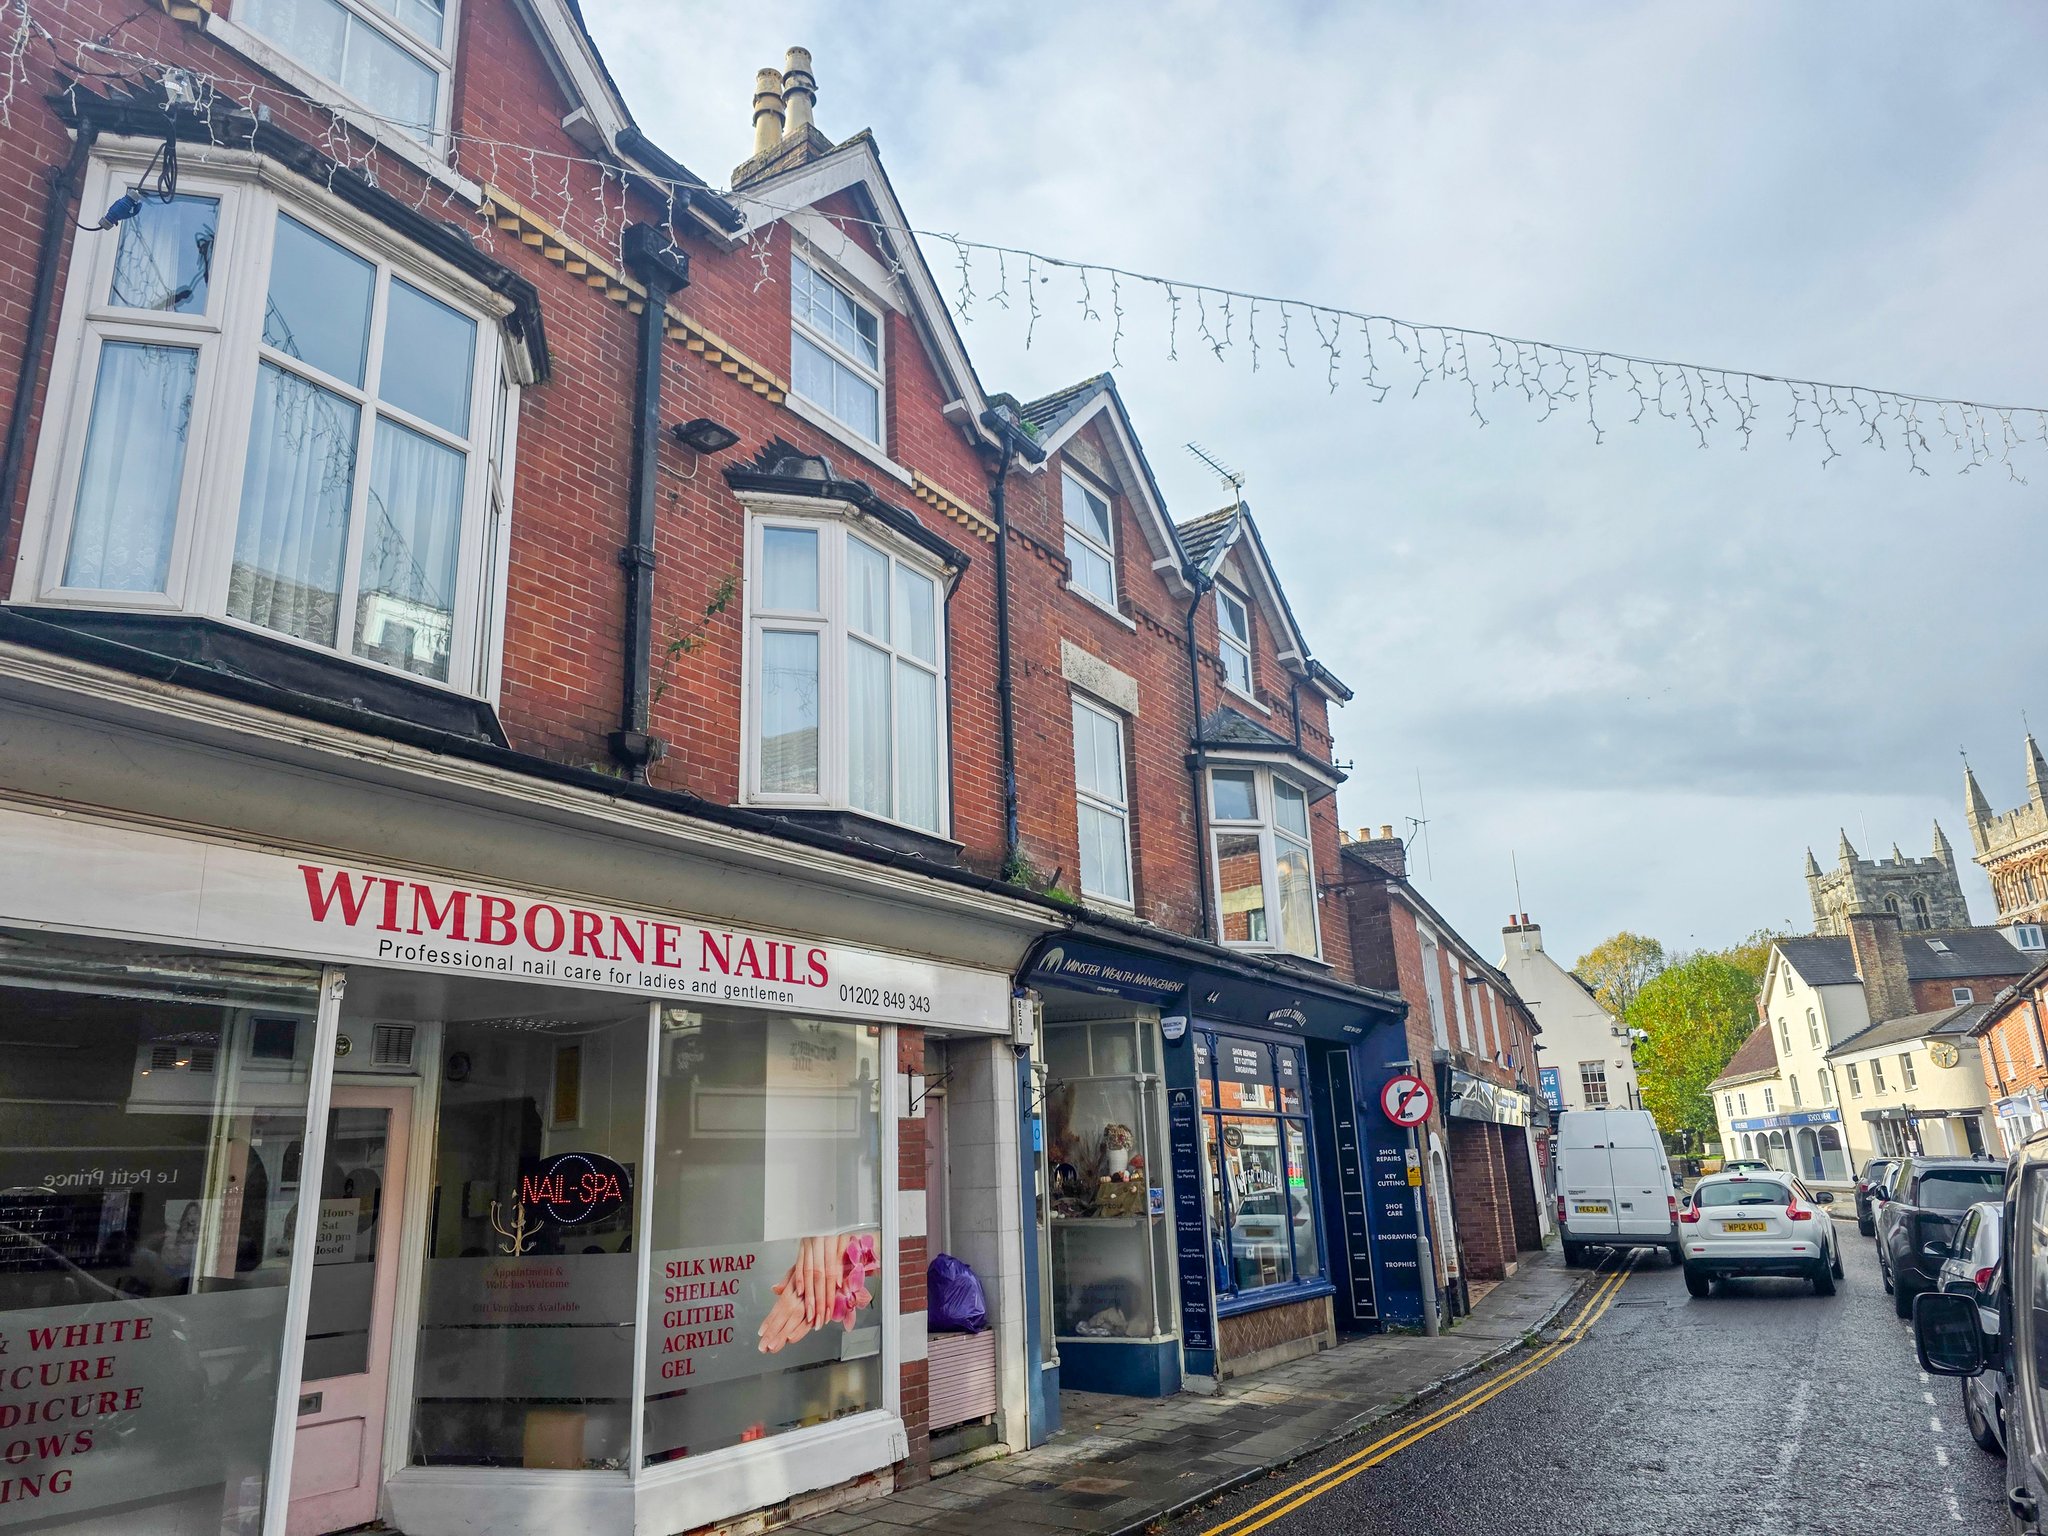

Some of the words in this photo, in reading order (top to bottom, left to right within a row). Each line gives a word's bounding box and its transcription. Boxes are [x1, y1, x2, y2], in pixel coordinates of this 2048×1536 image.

[298, 864, 682, 969] WIMBORNE
[698, 929, 830, 988] NAILS
[378, 938, 514, 971] Professional
[522, 959, 556, 976] nail
[564, 963, 602, 981] care
[610, 967, 632, 985] for
[638, 970, 685, 990] ladies
[692, 978, 717, 994] and
[724, 983, 794, 1003] gentlemen
[839, 983, 880, 1007] 01202
[883, 989, 906, 1010] 849
[909, 994, 931, 1013] 343
[1206, 990, 1221, 1004] 44
[321, 1221, 339, 1230] Sat
[322, 1208, 354, 1218] Hours
[1378, 1233, 1417, 1241] ENGRAVING
[1728, 1223, 1746, 1231] WP12
[1748, 1222, 1764, 1231] KOJ
[316, 1244, 344, 1255] losed
[665, 1259, 706, 1279] SILK
[710, 1254, 755, 1276] WRAP
[664, 1279, 740, 1304] SHELLAC
[663, 1303, 735, 1329] GLITTER
[27, 1317, 153, 1351] WHITE
[661, 1327, 735, 1355] ACRYLIC
[661, 1358, 696, 1379] GEL
